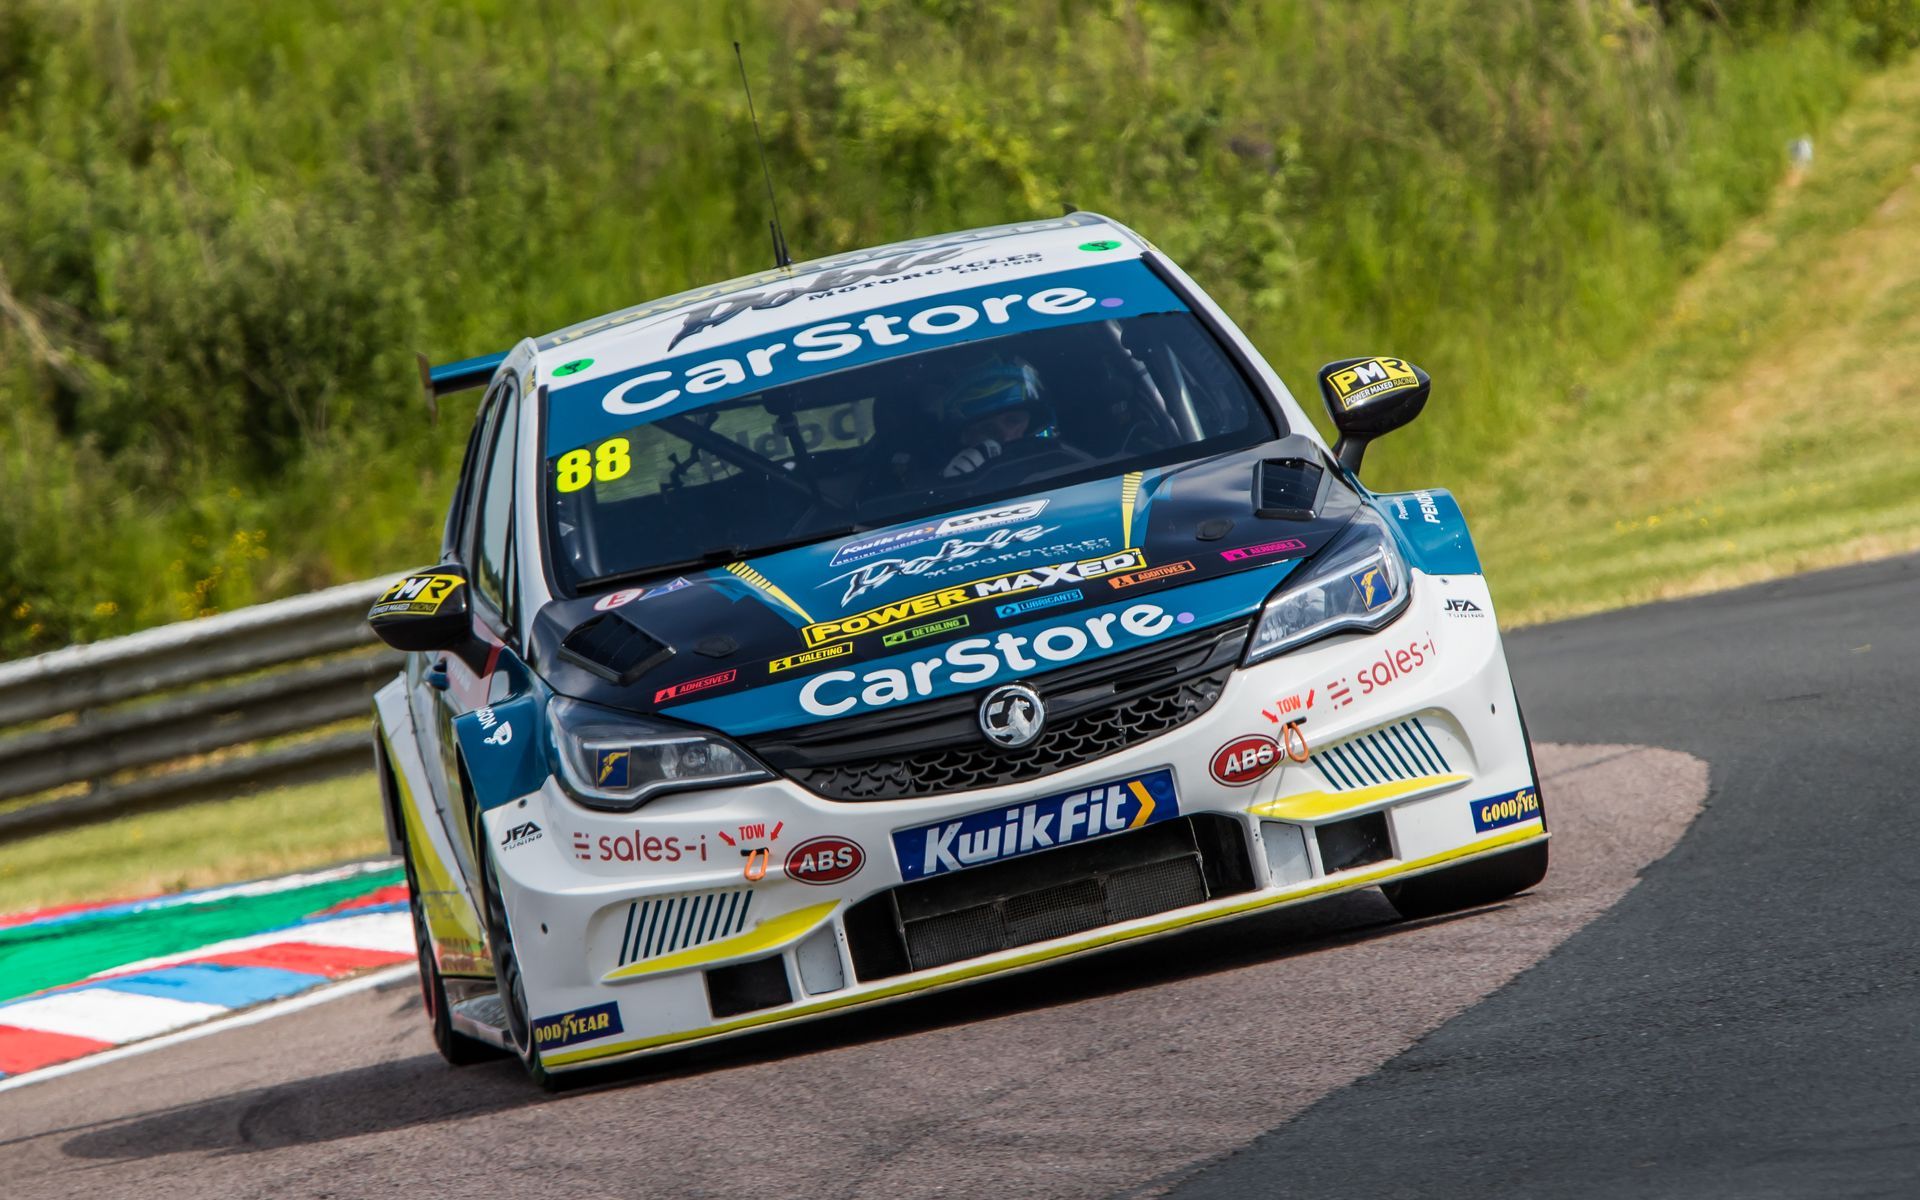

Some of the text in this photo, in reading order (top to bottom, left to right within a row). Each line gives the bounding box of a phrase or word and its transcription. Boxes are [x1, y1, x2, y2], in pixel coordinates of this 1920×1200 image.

[807, 251, 1042, 301] MOTORCYCLES
[1333, 358, 1409, 394] PMR
[1345, 375, 1416, 406] POWER MAXED RACING
[557, 437, 631, 493] 88
[948, 505, 1034, 528] BTCC
[923, 537, 1110, 579] MOTORCYCLES
[1250, 540, 1297, 557] AEROSOLS
[1137, 563, 1187, 580] ADDITIVES
[379, 576, 453, 602] PMR
[606, 592, 626, 608] E
[1020, 590, 1080, 611] LUBRICANTS
[811, 588, 971, 642] POWER
[1444, 599, 1482, 612] JFA
[912, 619, 960, 637] DETAILING
[799, 645, 843, 663] VALETING
[1357, 631, 1437, 695] sales-i
[679, 672, 729, 693] ADHESIVES
[1276, 695, 1301, 716] TOW
[1223, 743, 1274, 777] ABS
[1481, 790, 1539, 823] GOODYEA
[501, 821, 541, 846] JFA
[502, 833, 543, 852] TUNING
[738, 823, 766, 841] TOW
[598, 829, 707, 862] sales-i
[798, 846, 853, 874] ABS
[535, 1012, 609, 1043] OODYEAR
